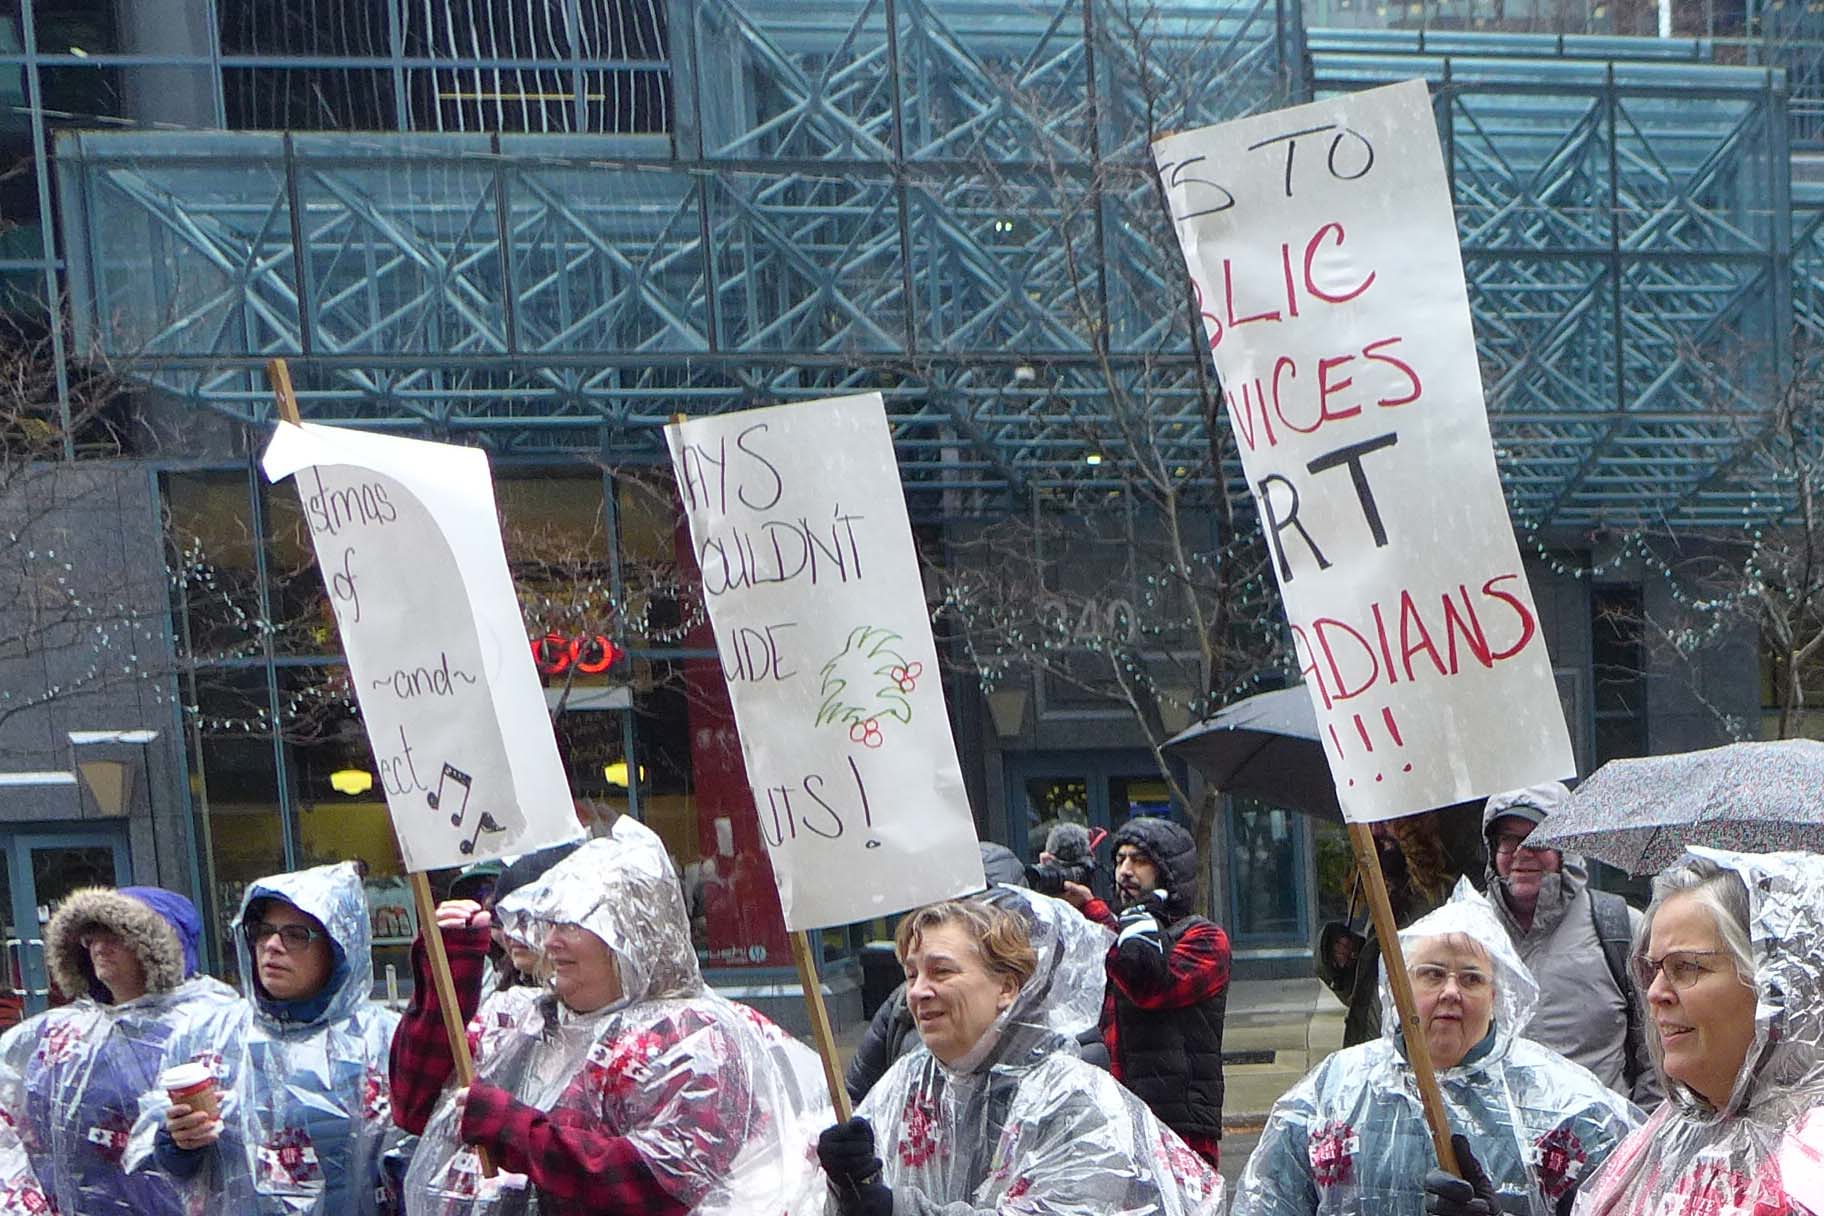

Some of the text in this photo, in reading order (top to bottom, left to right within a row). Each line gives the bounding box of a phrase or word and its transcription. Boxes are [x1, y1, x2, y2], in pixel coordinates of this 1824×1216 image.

[1157, 124, 1375, 222] S TO
[1225, 337, 1423, 451] VICES
[674, 423, 783, 515] AYS
[1257, 432, 1399, 583] RT
[333, 548, 360, 624] of
[1328, 706, 1414, 787] !!!
[1692, 1196, 1715, 1212] UTE
